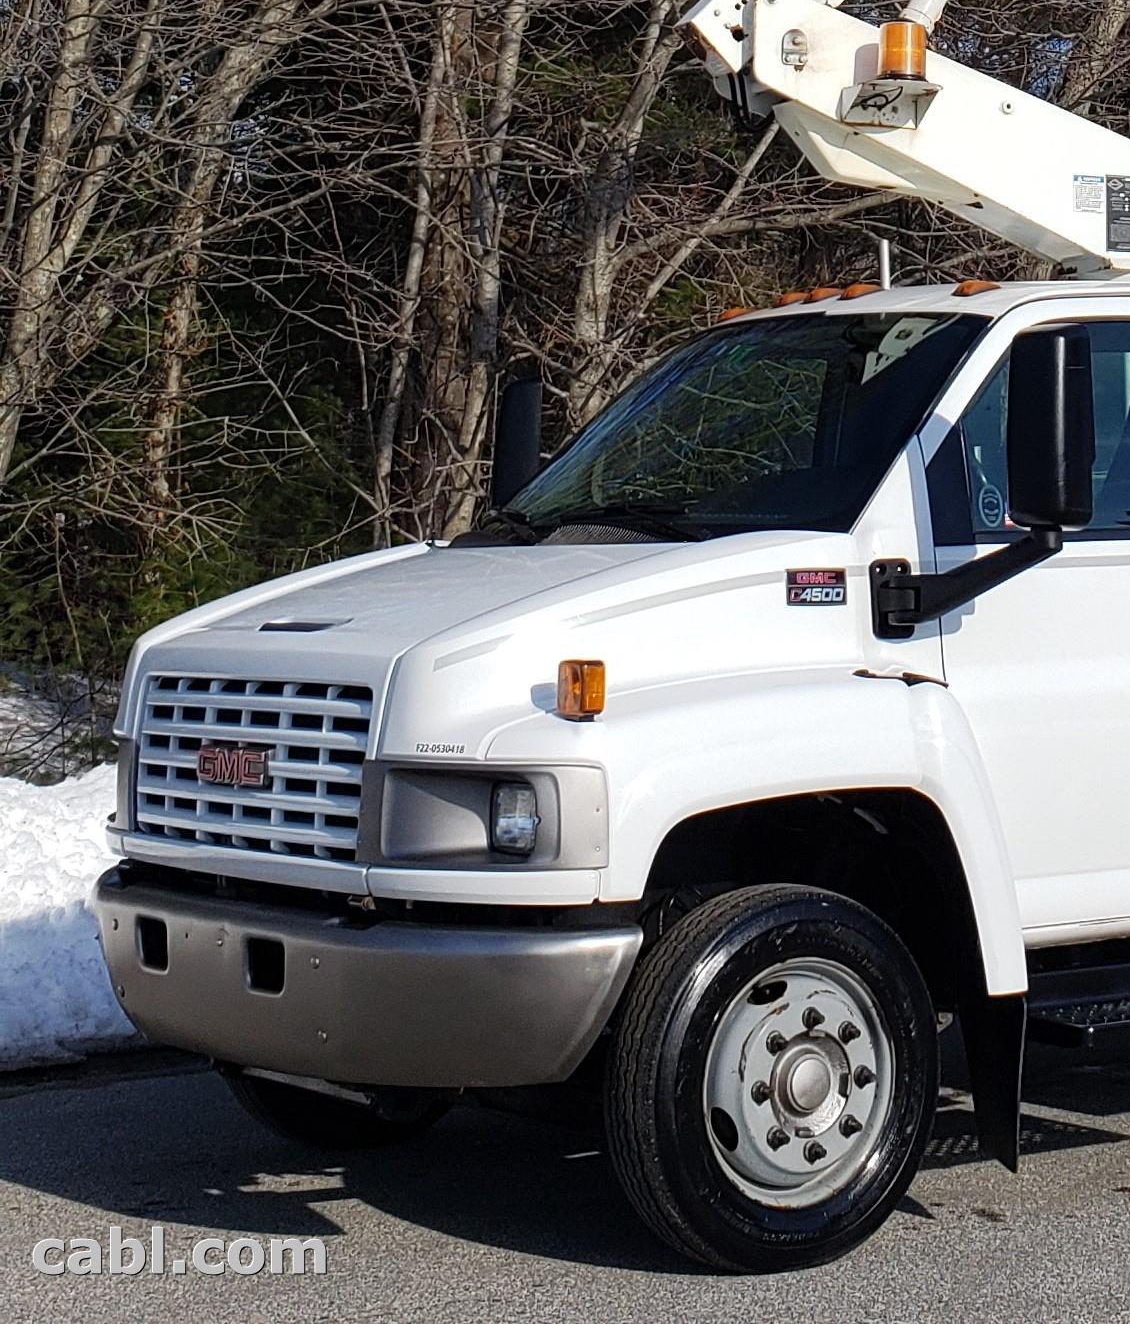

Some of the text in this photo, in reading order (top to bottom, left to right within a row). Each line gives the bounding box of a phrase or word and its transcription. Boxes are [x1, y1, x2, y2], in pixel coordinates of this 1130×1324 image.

[796, 572, 836, 584] GMC
[789, 588, 844, 602] C4500
[197, 748, 265, 786] GMC
